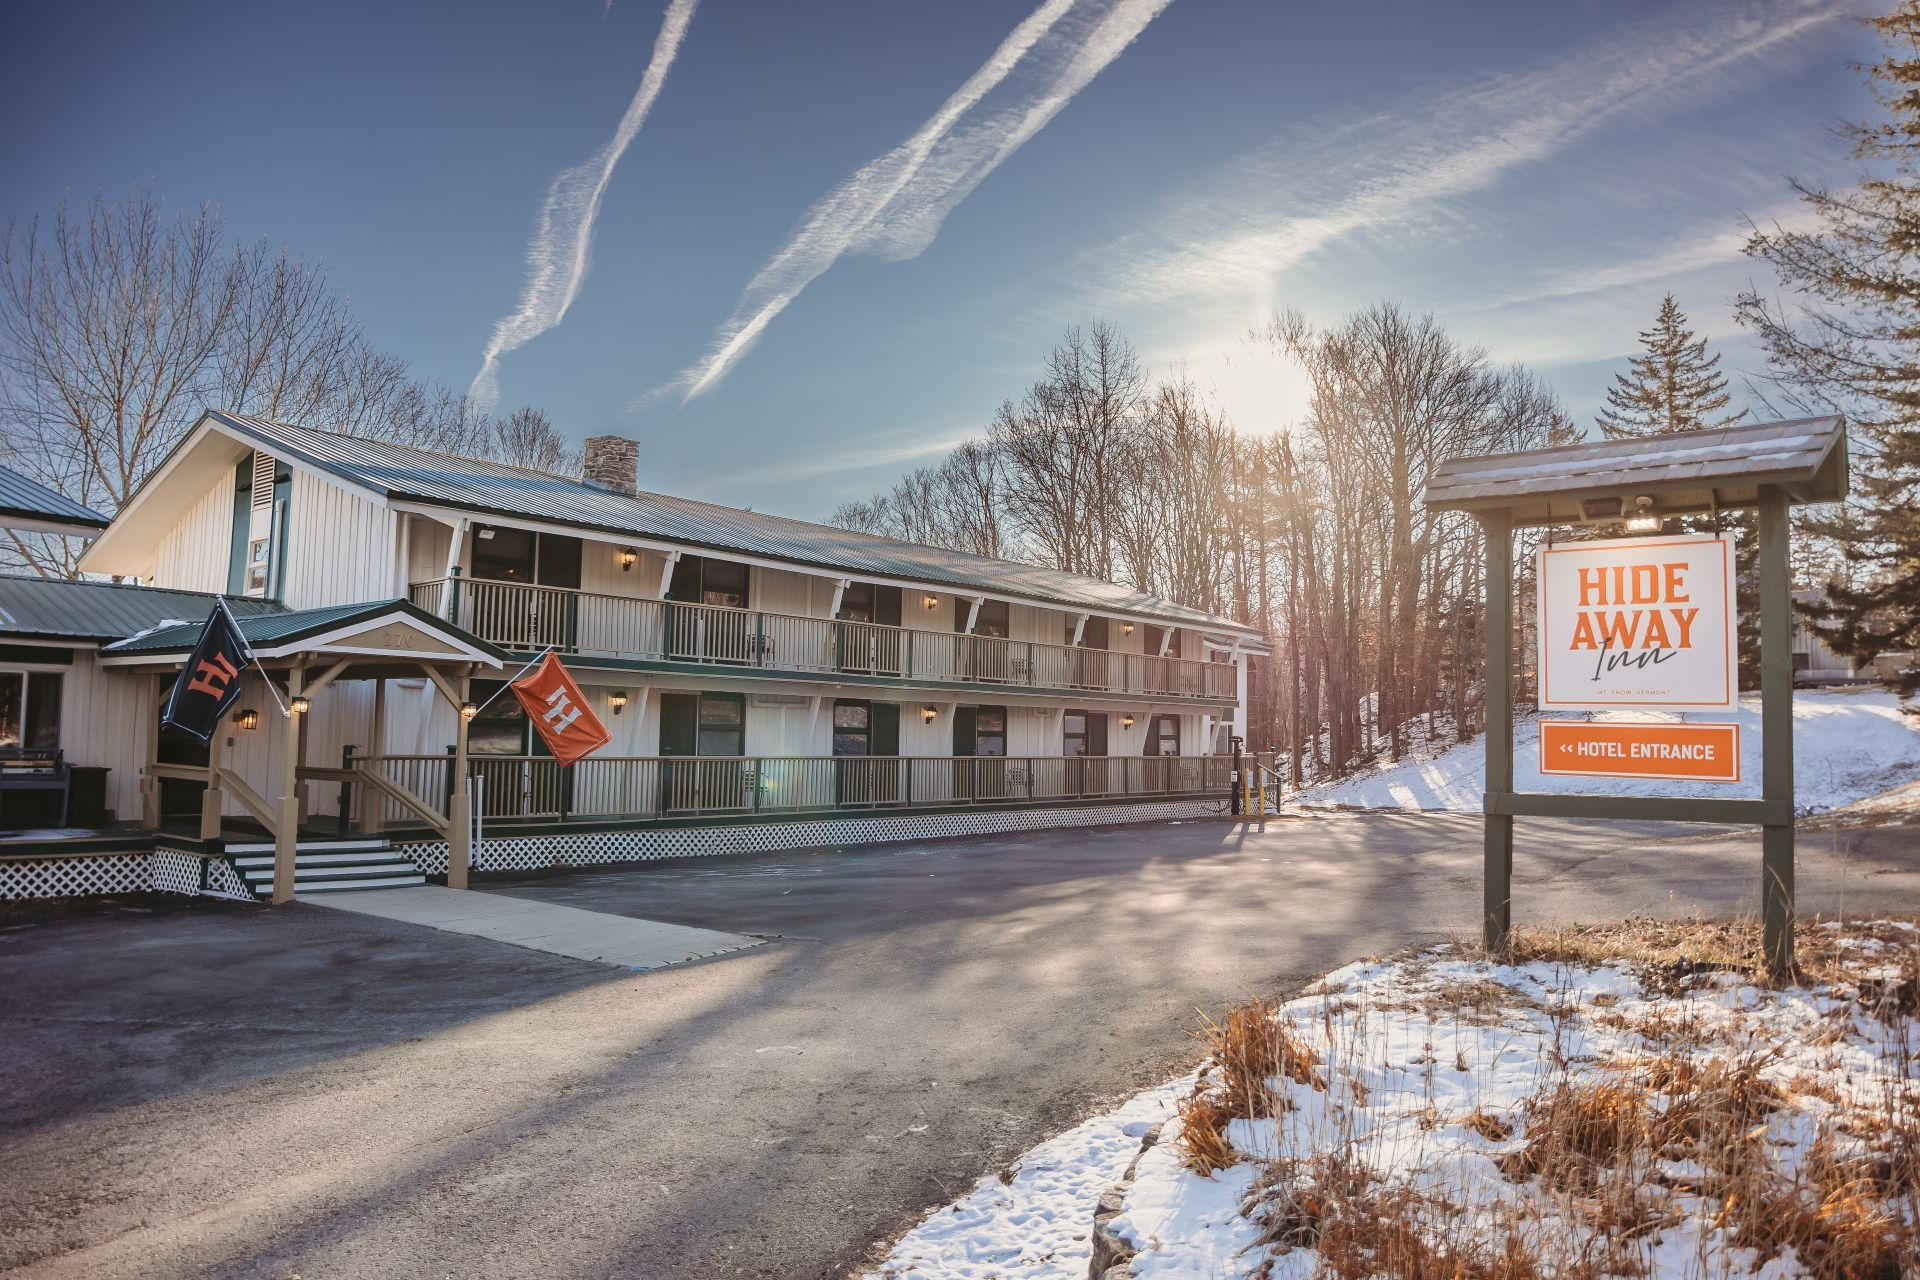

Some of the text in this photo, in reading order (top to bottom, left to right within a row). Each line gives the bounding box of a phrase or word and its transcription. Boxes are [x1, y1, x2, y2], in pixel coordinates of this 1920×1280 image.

[1577, 563, 1690, 606] HIDE
[382, 632, 415, 648] 270
[1569, 608, 1700, 650] AWAY
[1590, 637, 1678, 682] Inn
[1577, 741, 1715, 761] HOTEL ENTRANCE
